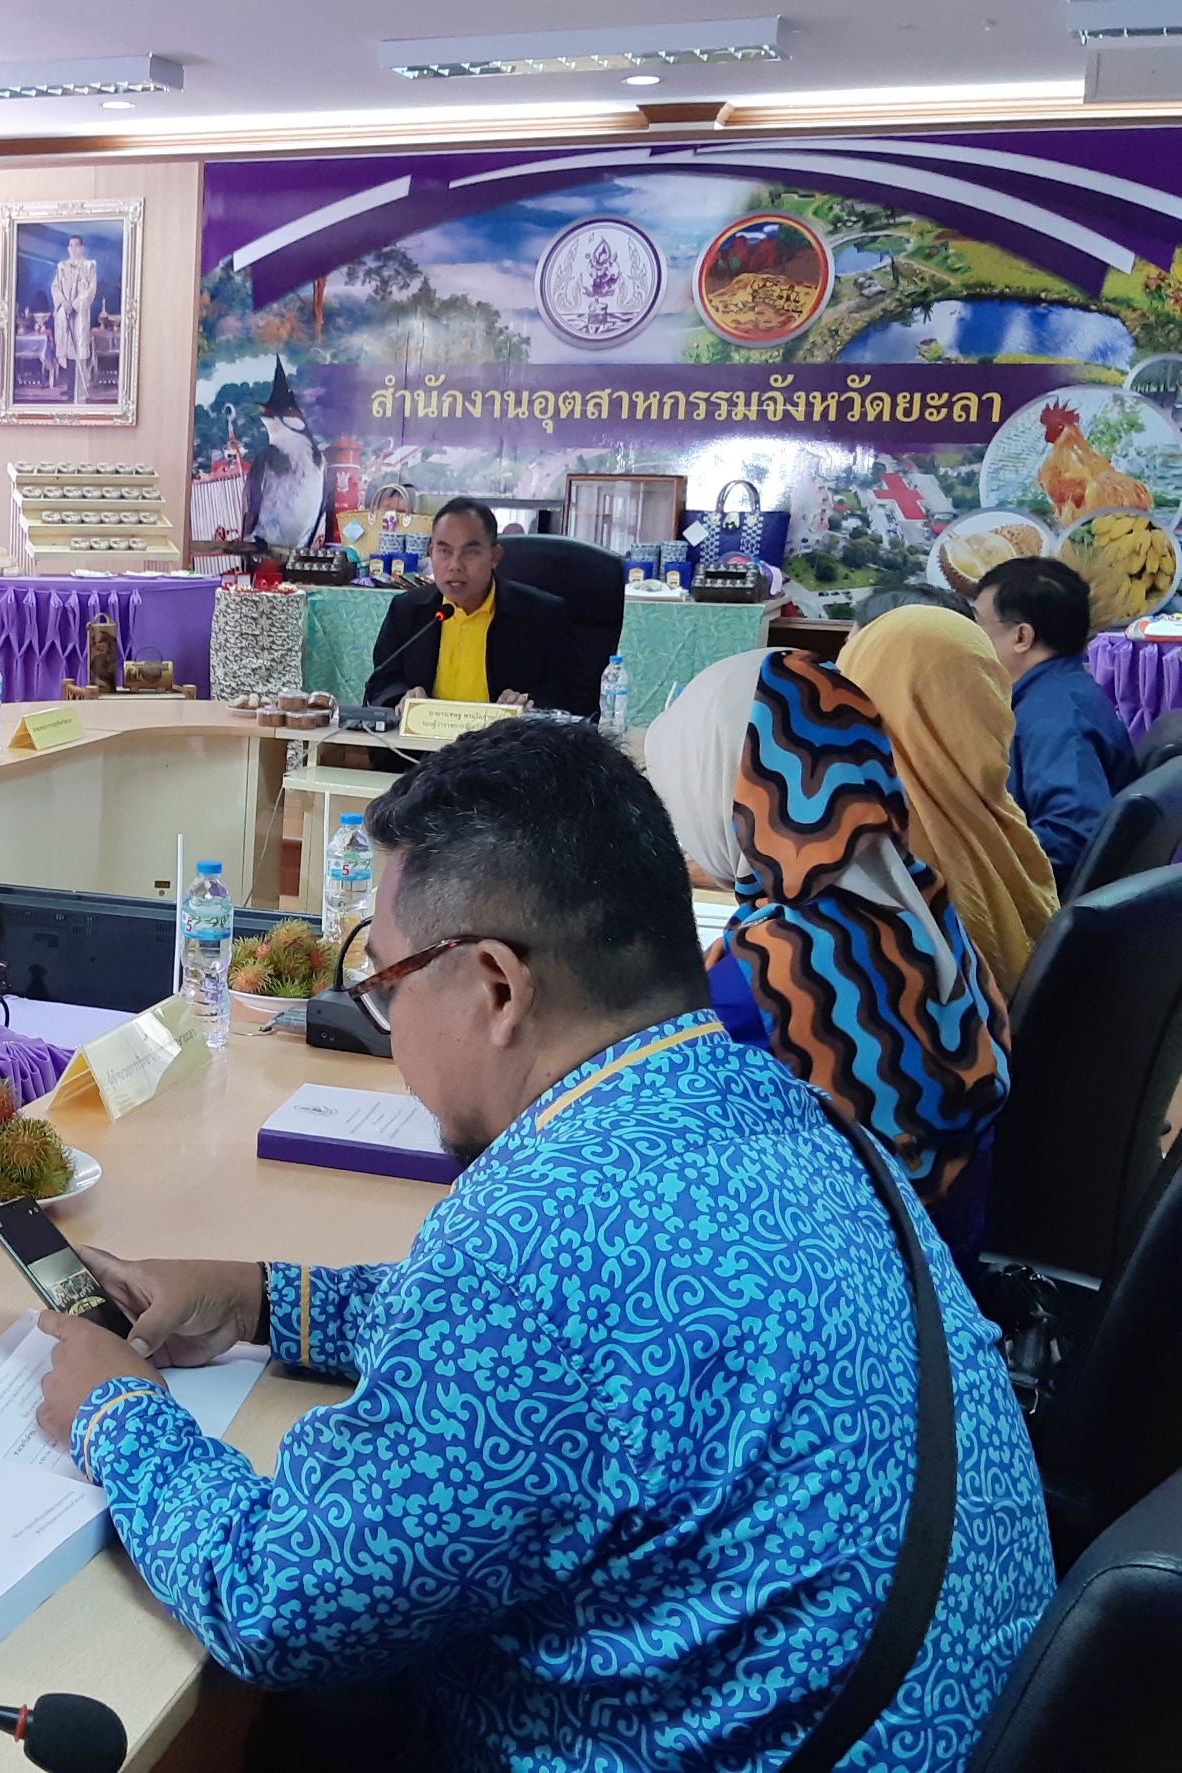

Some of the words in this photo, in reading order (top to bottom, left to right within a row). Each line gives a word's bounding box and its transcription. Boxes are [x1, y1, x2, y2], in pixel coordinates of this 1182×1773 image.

[370, 373, 1003, 434] สำนักงานอุตสาหกรรมจังหวัดยะลา
